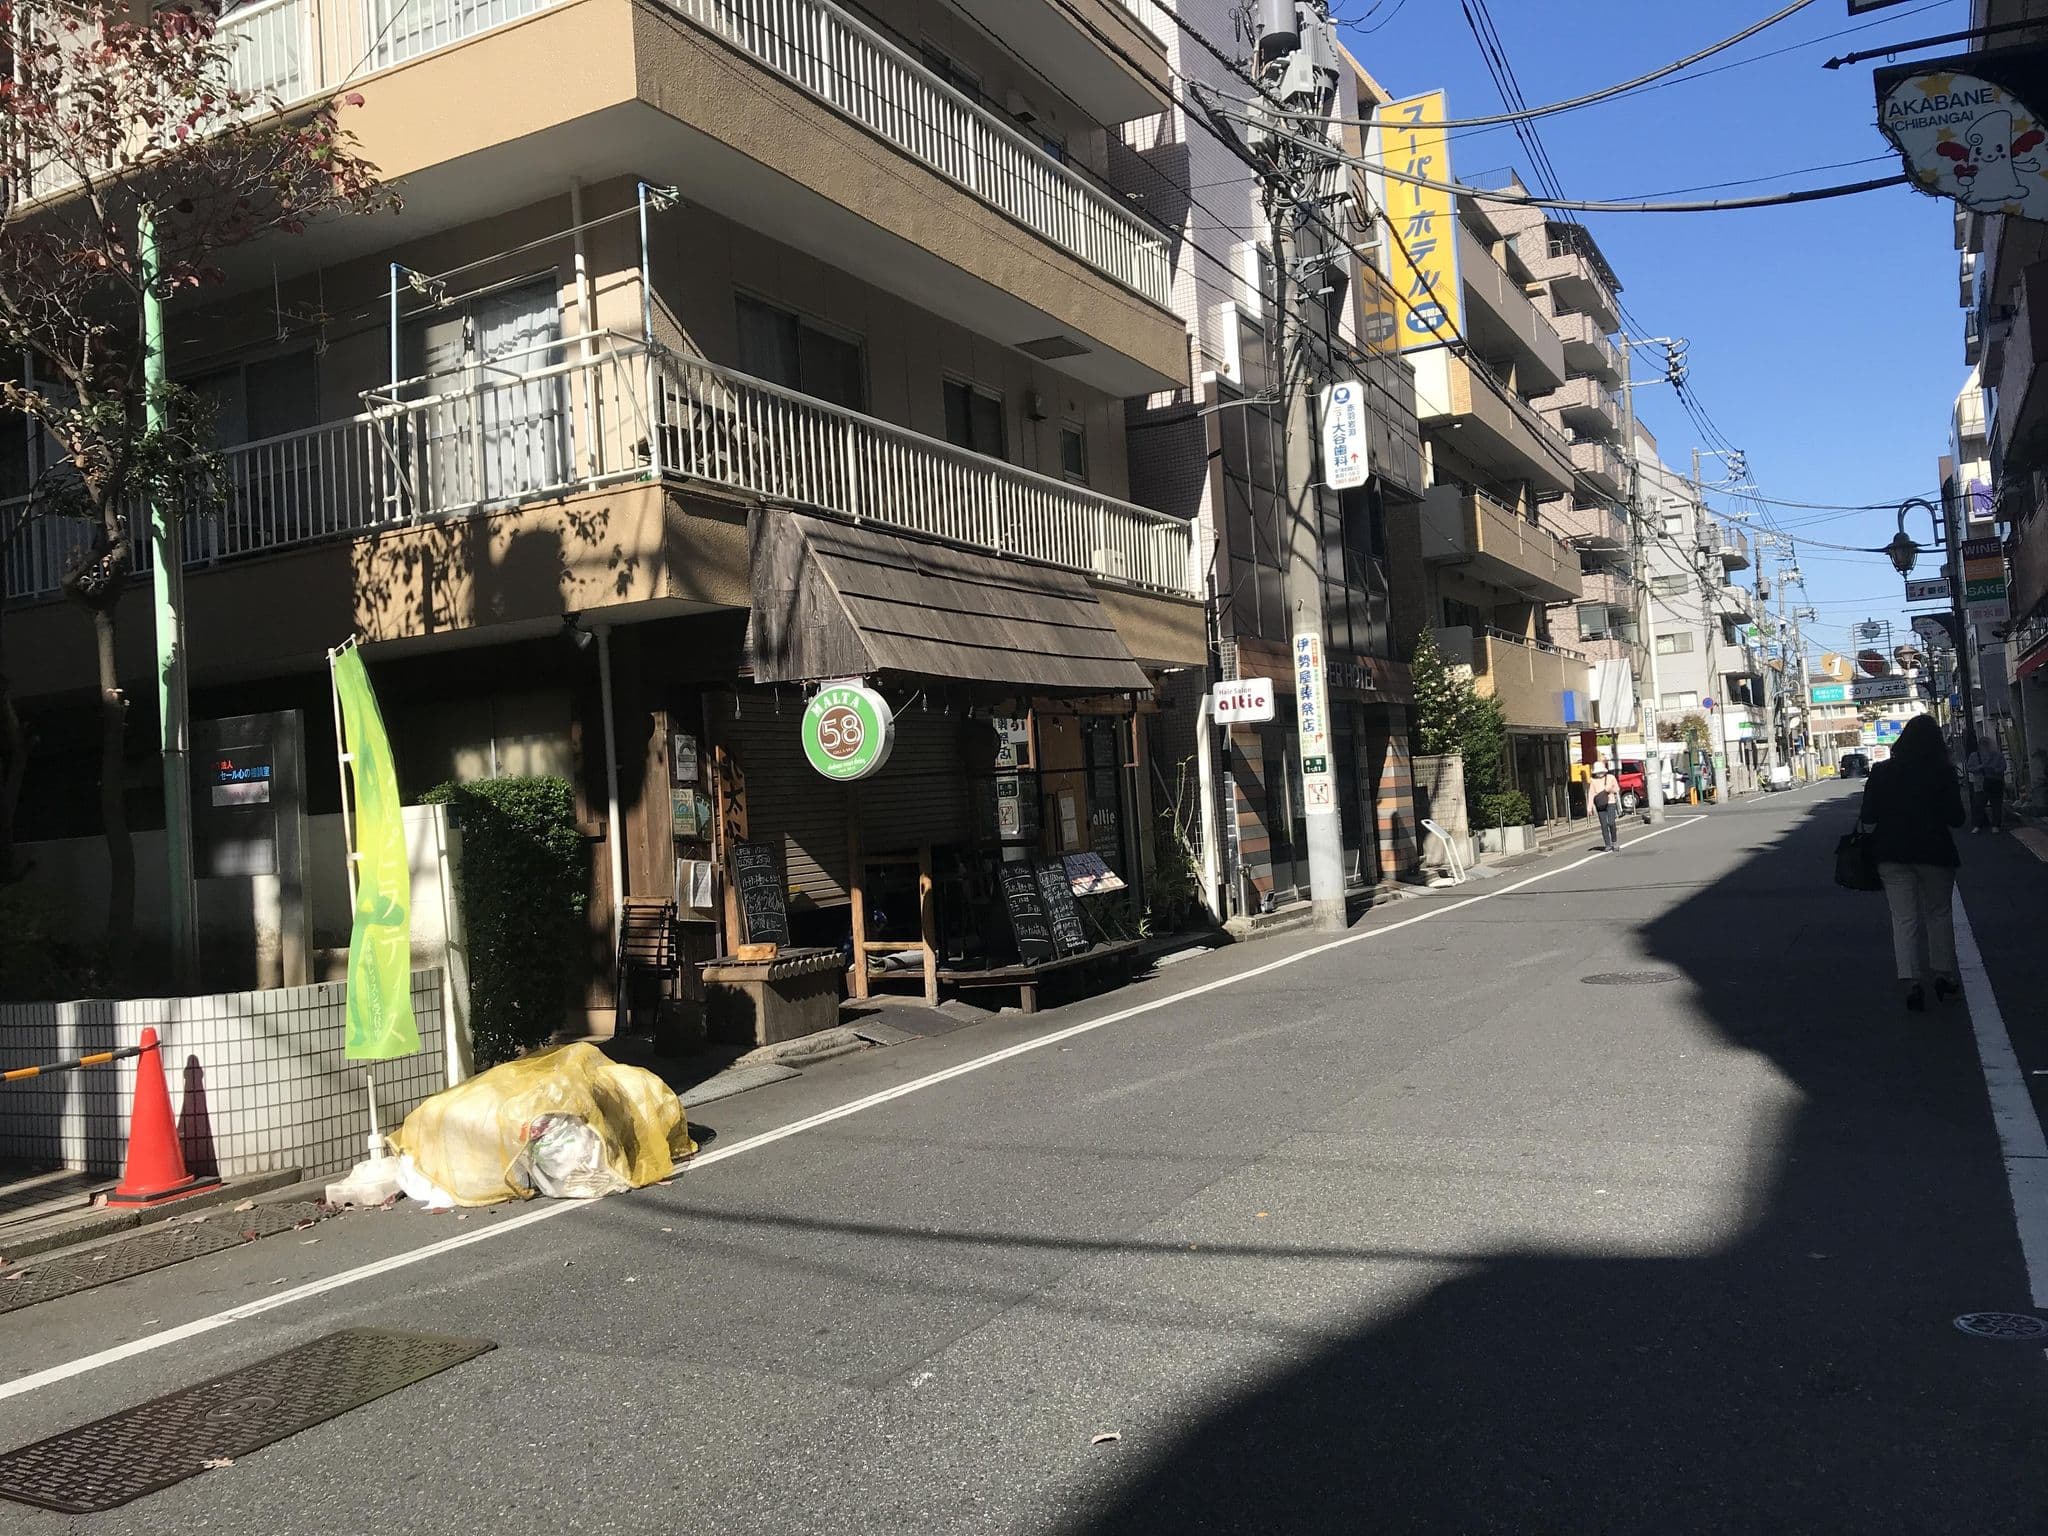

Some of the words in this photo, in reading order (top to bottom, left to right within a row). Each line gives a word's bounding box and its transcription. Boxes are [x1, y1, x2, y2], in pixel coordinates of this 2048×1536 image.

[1888, 87, 1995, 118] AKABANE
[1891, 110, 1974, 132] ICHIBANGAI
[1399, 103, 1441, 300] スーパーホテル
[1332, 424, 1348, 467] 大谷歯科
[1965, 542, 1999, 556] WINE
[1967, 583, 2005, 597] SAKE
[810, 691, 860, 718] MALTA
[1219, 694, 1265, 711] altie
[821, 714, 862, 750] 58
[1093, 808, 1115, 826] altie
